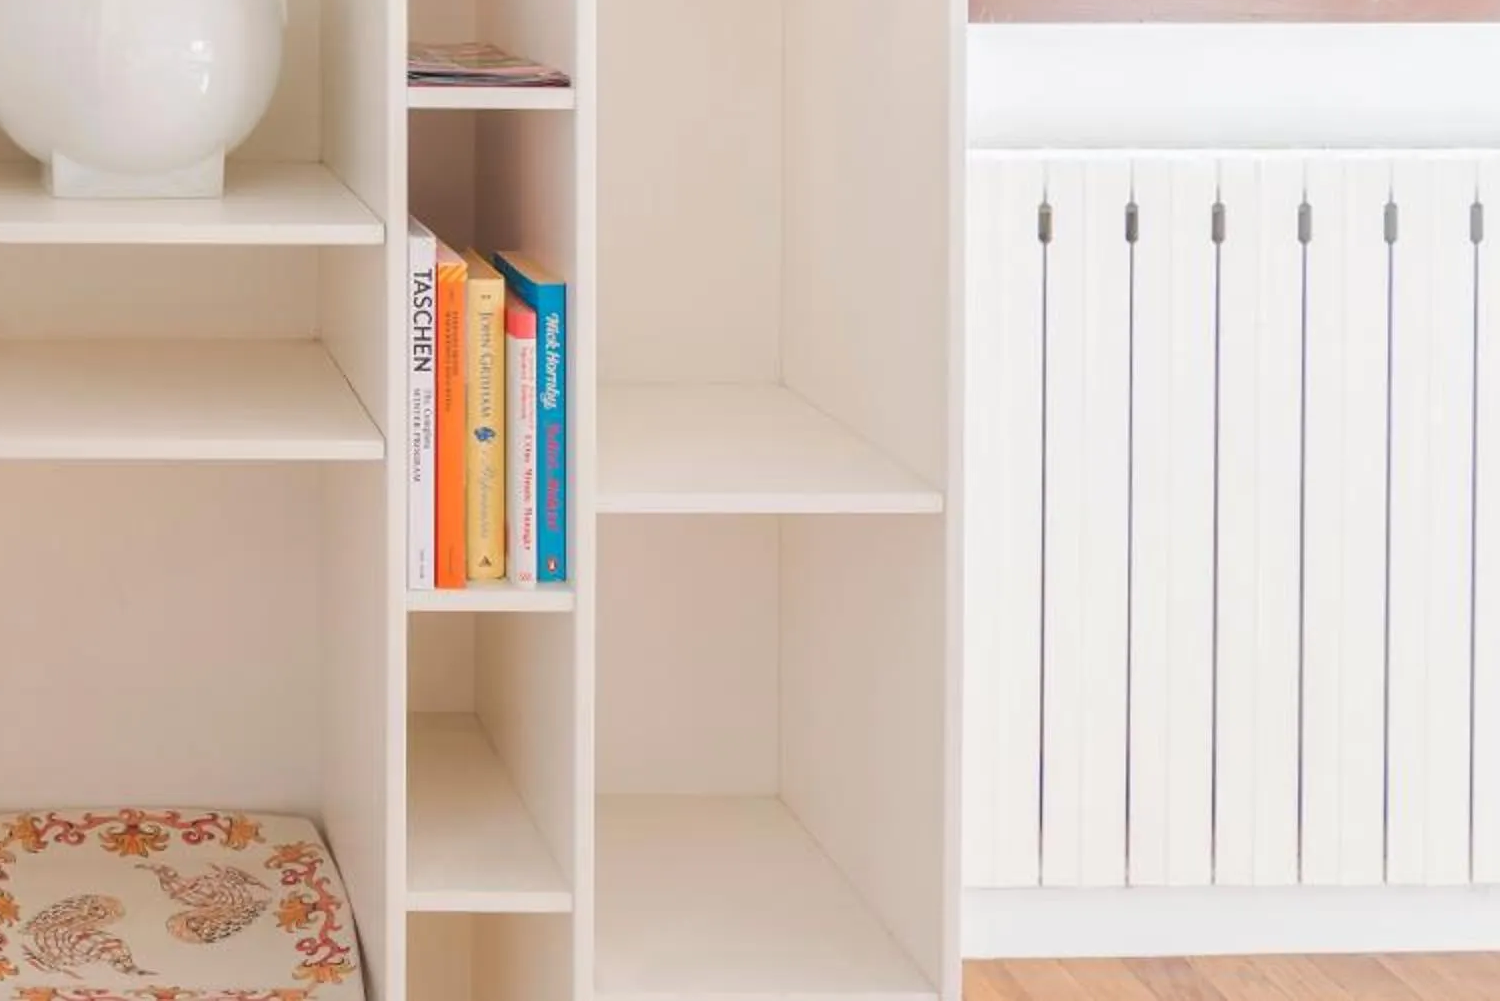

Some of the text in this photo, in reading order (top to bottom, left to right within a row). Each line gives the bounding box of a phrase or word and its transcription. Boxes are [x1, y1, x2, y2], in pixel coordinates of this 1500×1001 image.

[413, 268, 433, 373] TASCHEN
[478, 312, 494, 348] JOHN
[545, 312, 562, 349] Nick
[539, 349, 562, 411] Hornby
